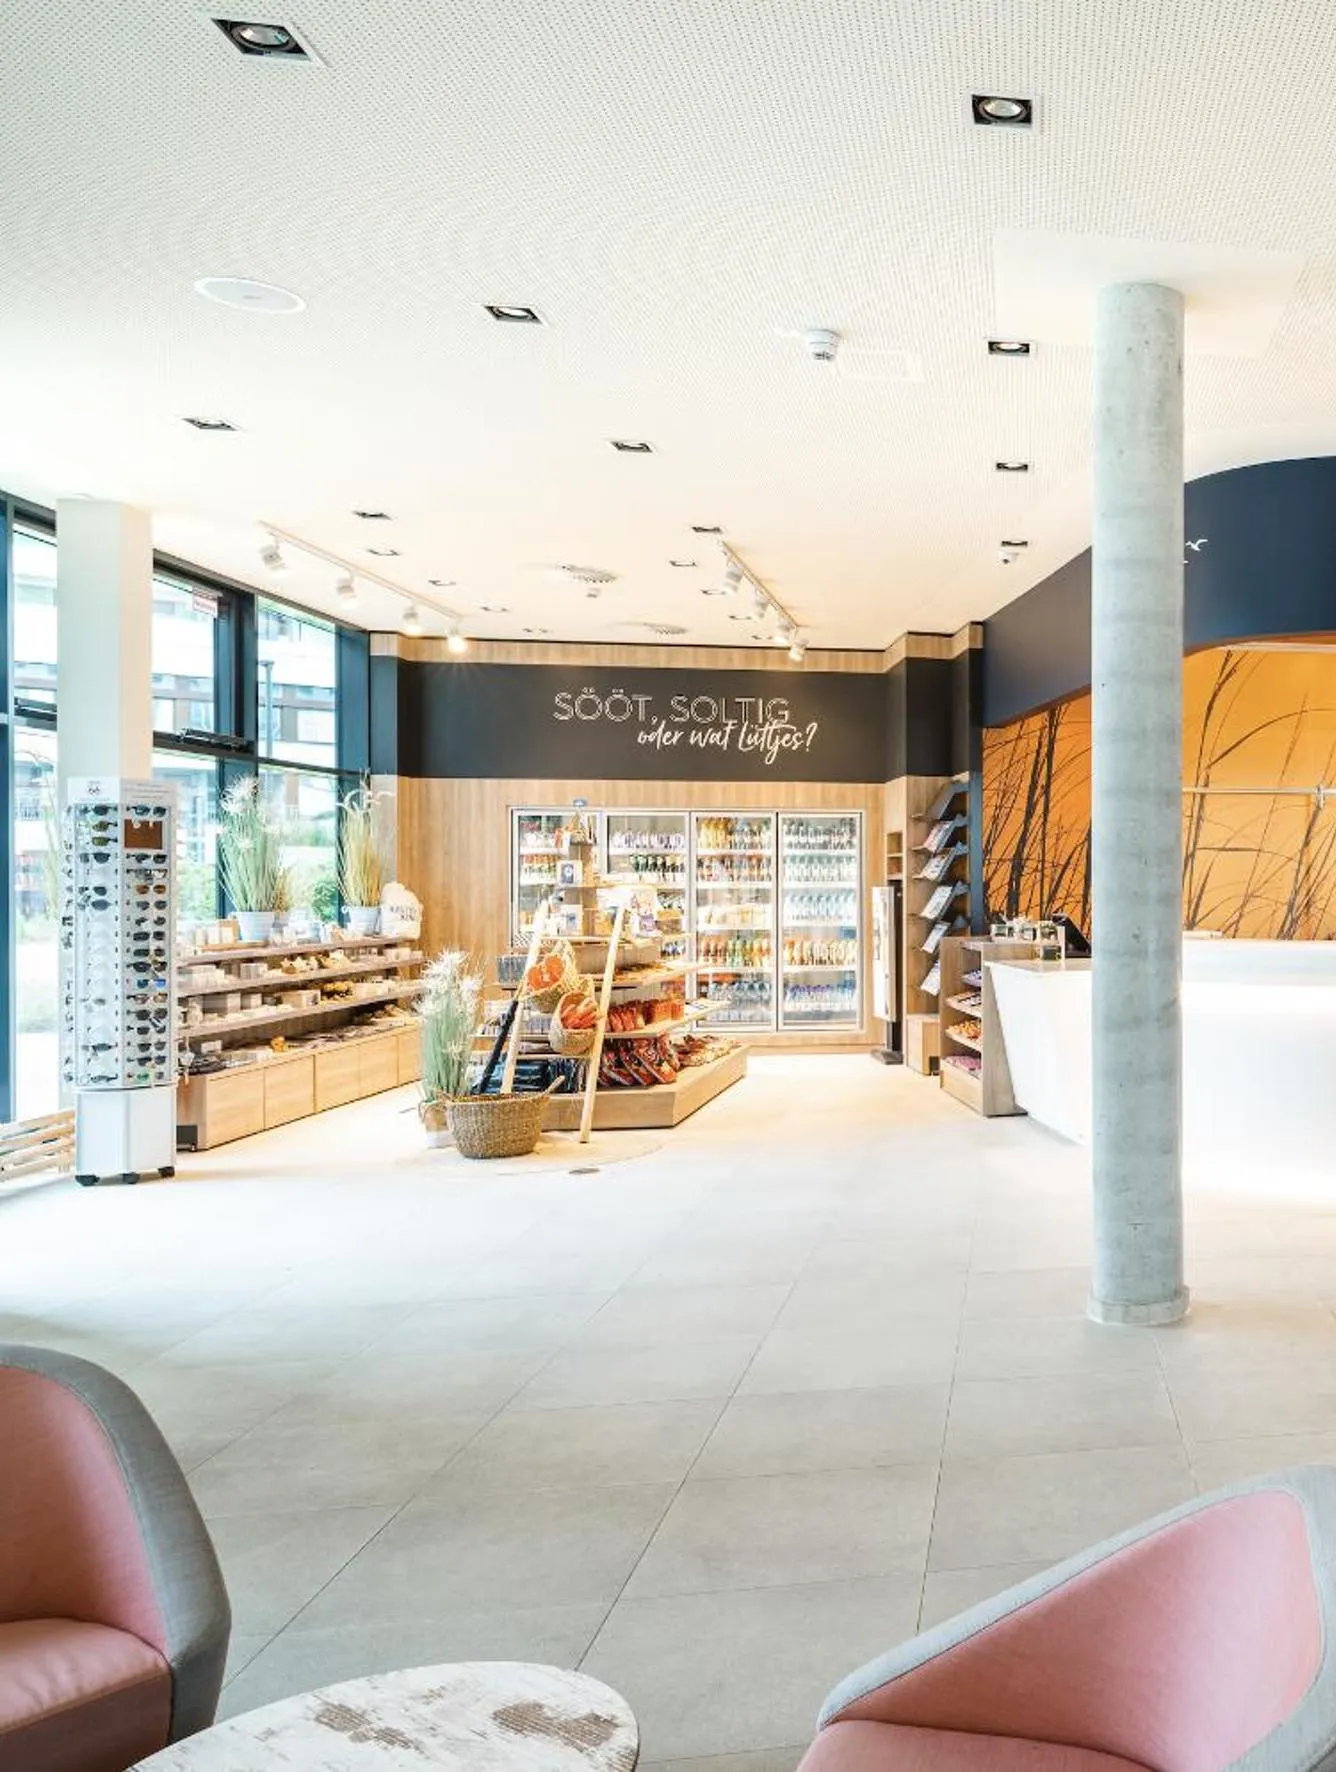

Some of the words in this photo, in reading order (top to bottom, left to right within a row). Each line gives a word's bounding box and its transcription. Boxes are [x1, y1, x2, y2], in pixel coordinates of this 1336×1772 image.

[553, 687, 658, 725] SÖÖT,
[669, 695, 789, 725] SOLTIG
[637, 720, 684, 749] oder
[690, 720, 738, 750] wat
